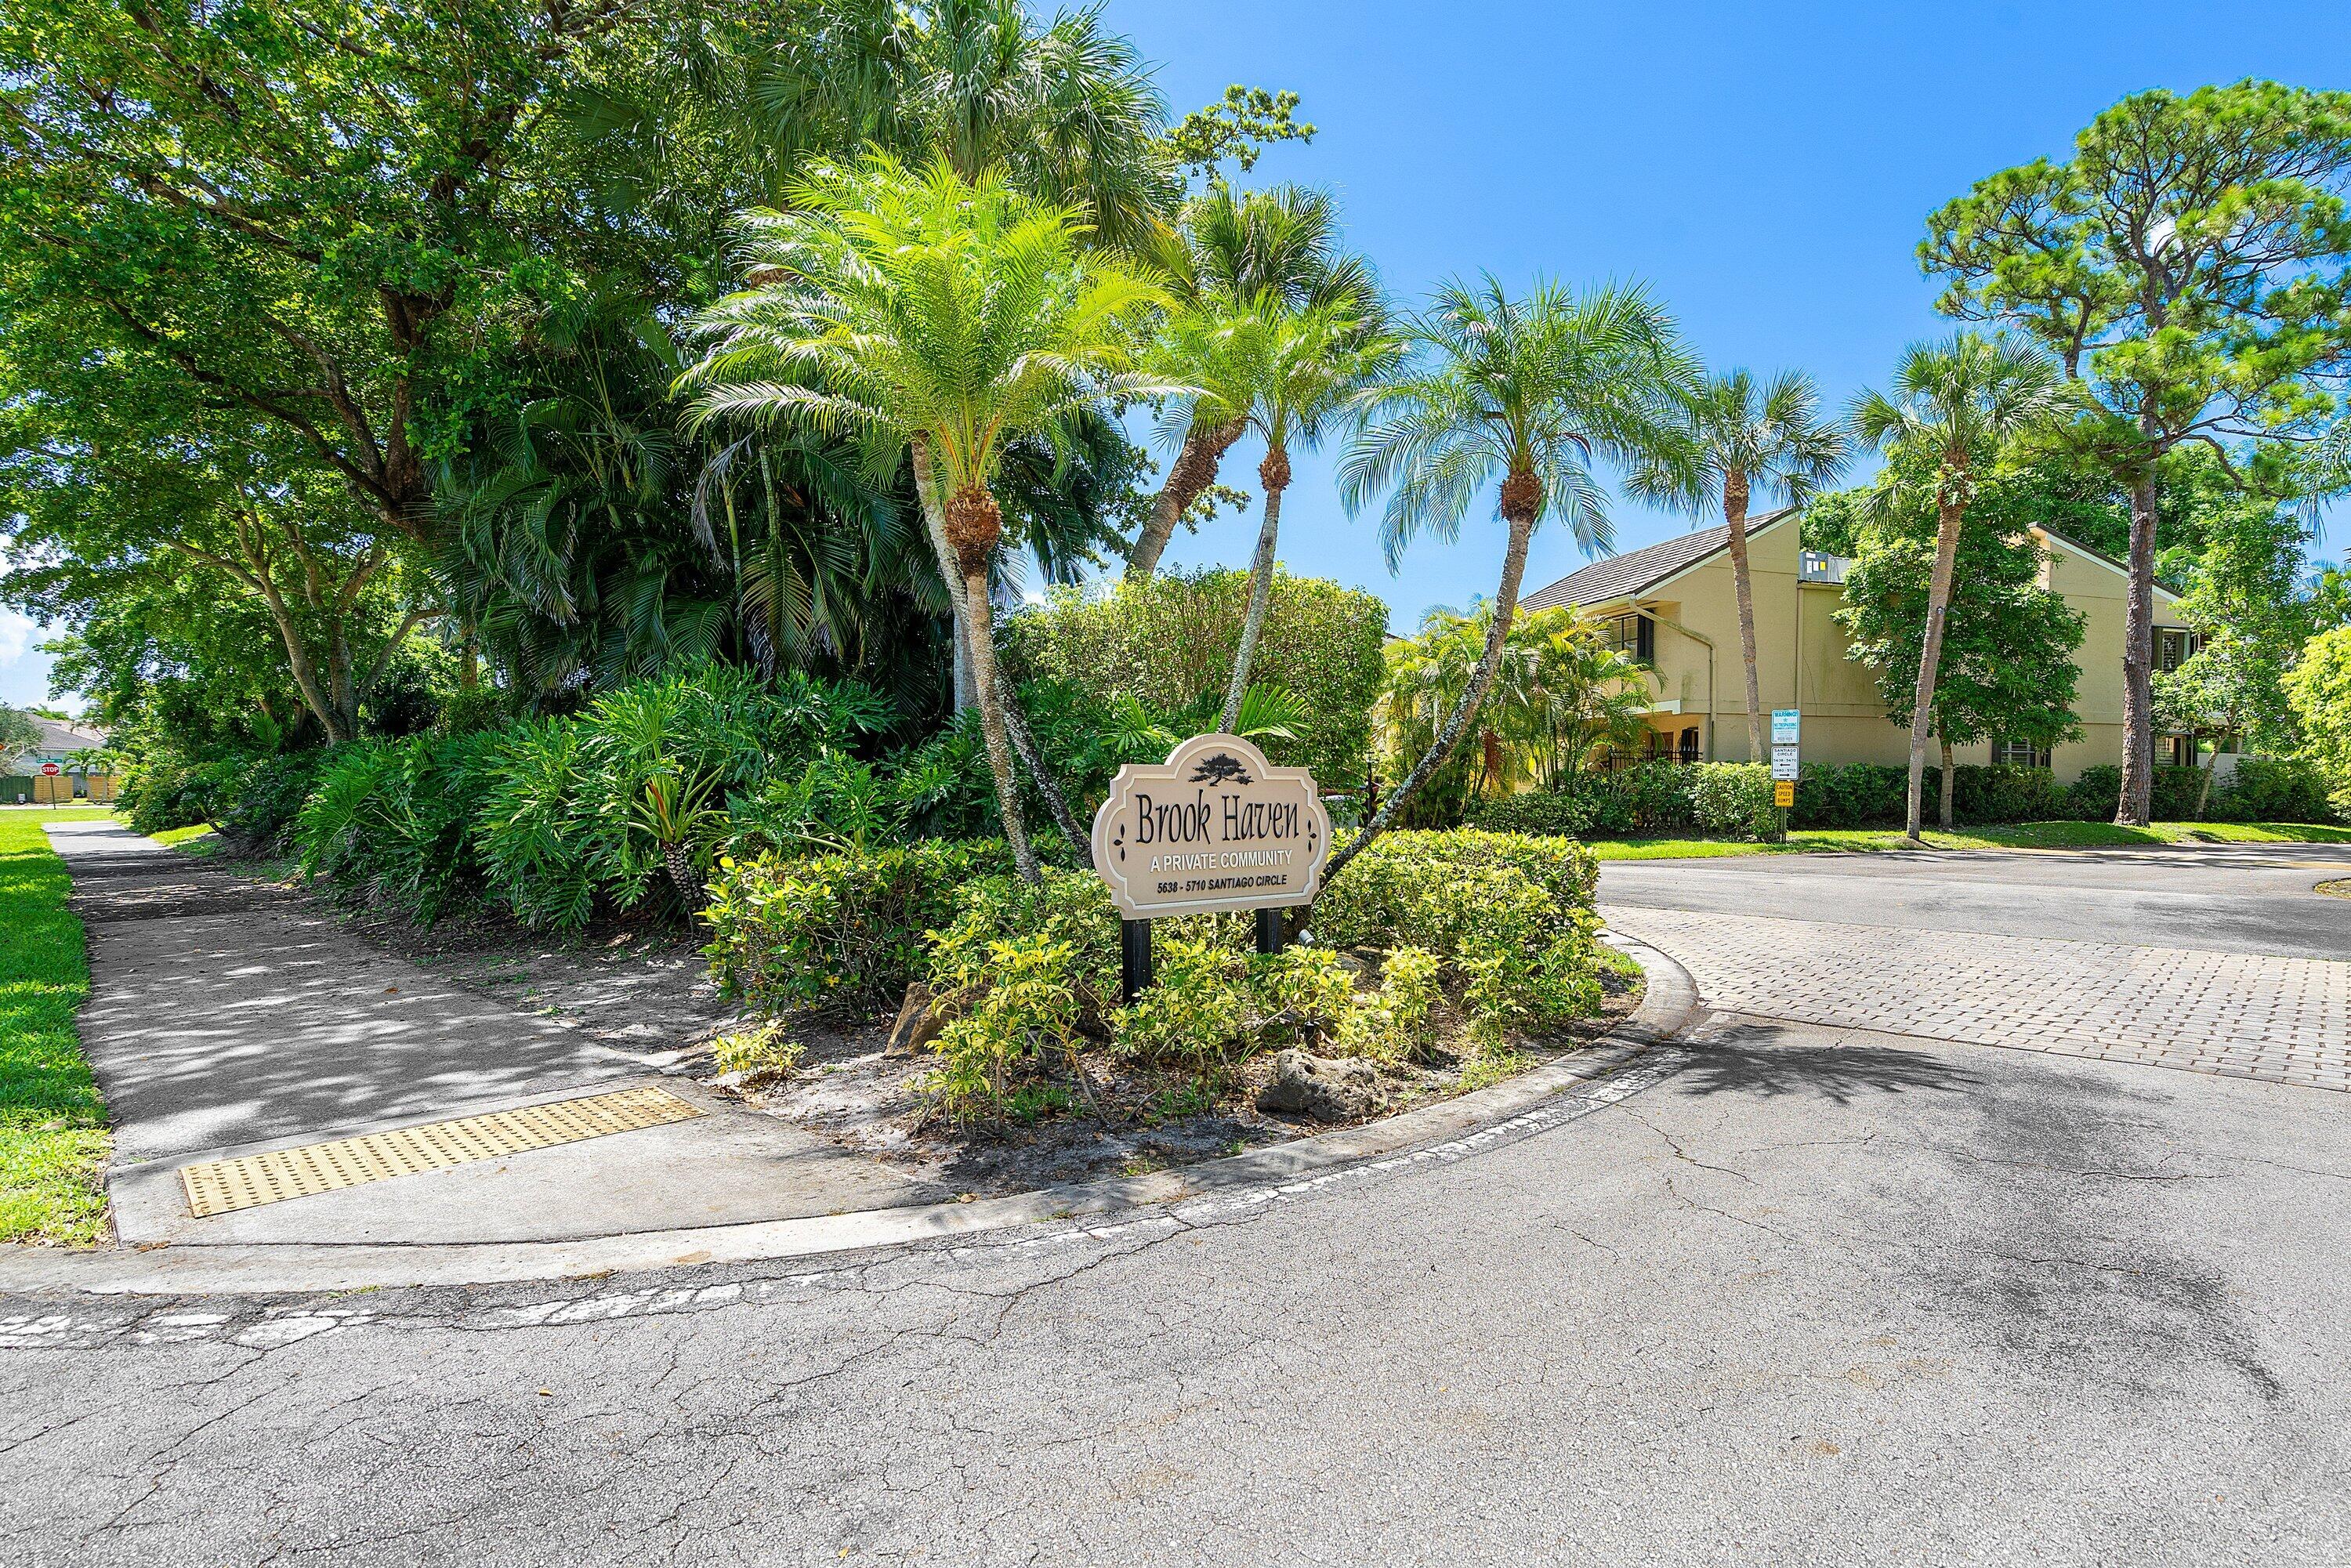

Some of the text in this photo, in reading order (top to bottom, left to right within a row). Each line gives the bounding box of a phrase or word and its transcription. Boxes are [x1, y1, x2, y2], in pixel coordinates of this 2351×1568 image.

[1135, 788, 1299, 846] Brook Haven
[1150, 849, 1293, 873] A PRIVATE COMMUNITY
[1157, 882, 1179, 894] 5638
[1186, 879, 1207, 892] 5710
[1208, 876, 1254, 890] SANTIAGO
[1255, 875, 1288, 887] CIRCLE
